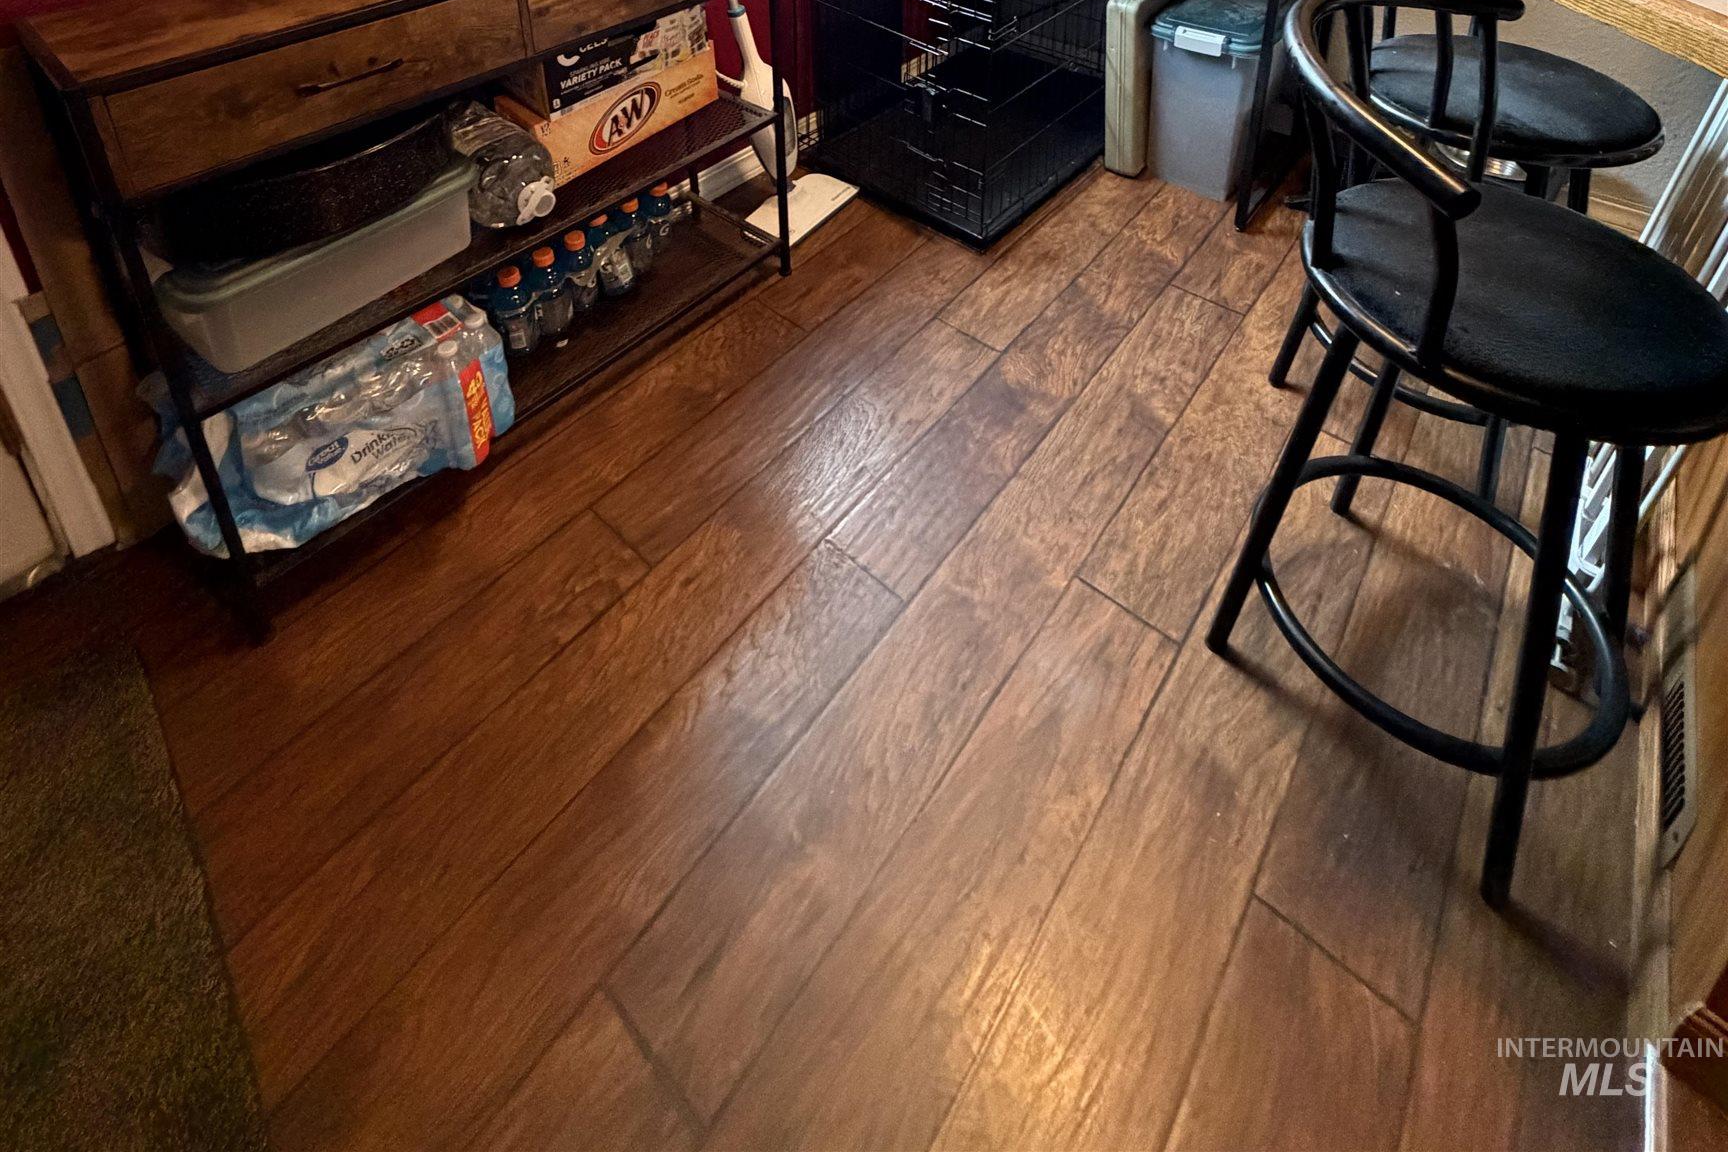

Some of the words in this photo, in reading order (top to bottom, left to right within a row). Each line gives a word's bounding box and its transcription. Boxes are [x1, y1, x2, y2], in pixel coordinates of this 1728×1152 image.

[560, 67, 598, 90] VARIETY
[599, 58, 623, 74] PACK
[606, 89, 646, 147] A&W
